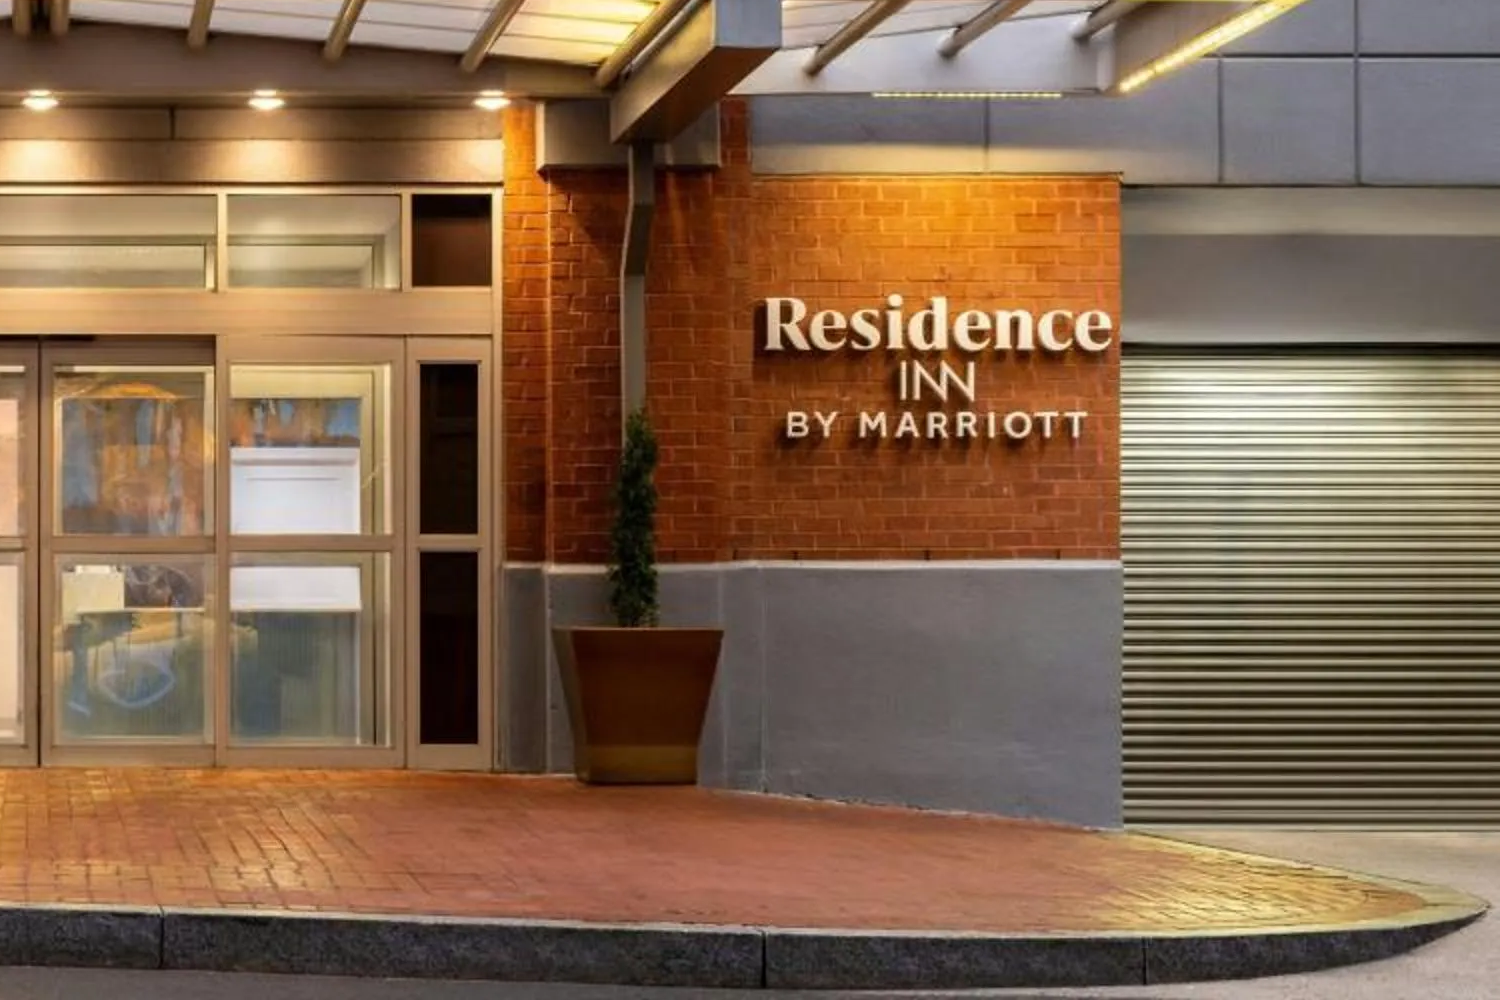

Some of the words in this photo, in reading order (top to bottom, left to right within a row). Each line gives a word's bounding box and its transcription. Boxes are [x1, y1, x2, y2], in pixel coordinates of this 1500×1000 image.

[764, 293, 1113, 353] Residence
[899, 360, 976, 402] INN
[786, 411, 840, 438] BY
[859, 411, 1088, 439] MARRIOTT
